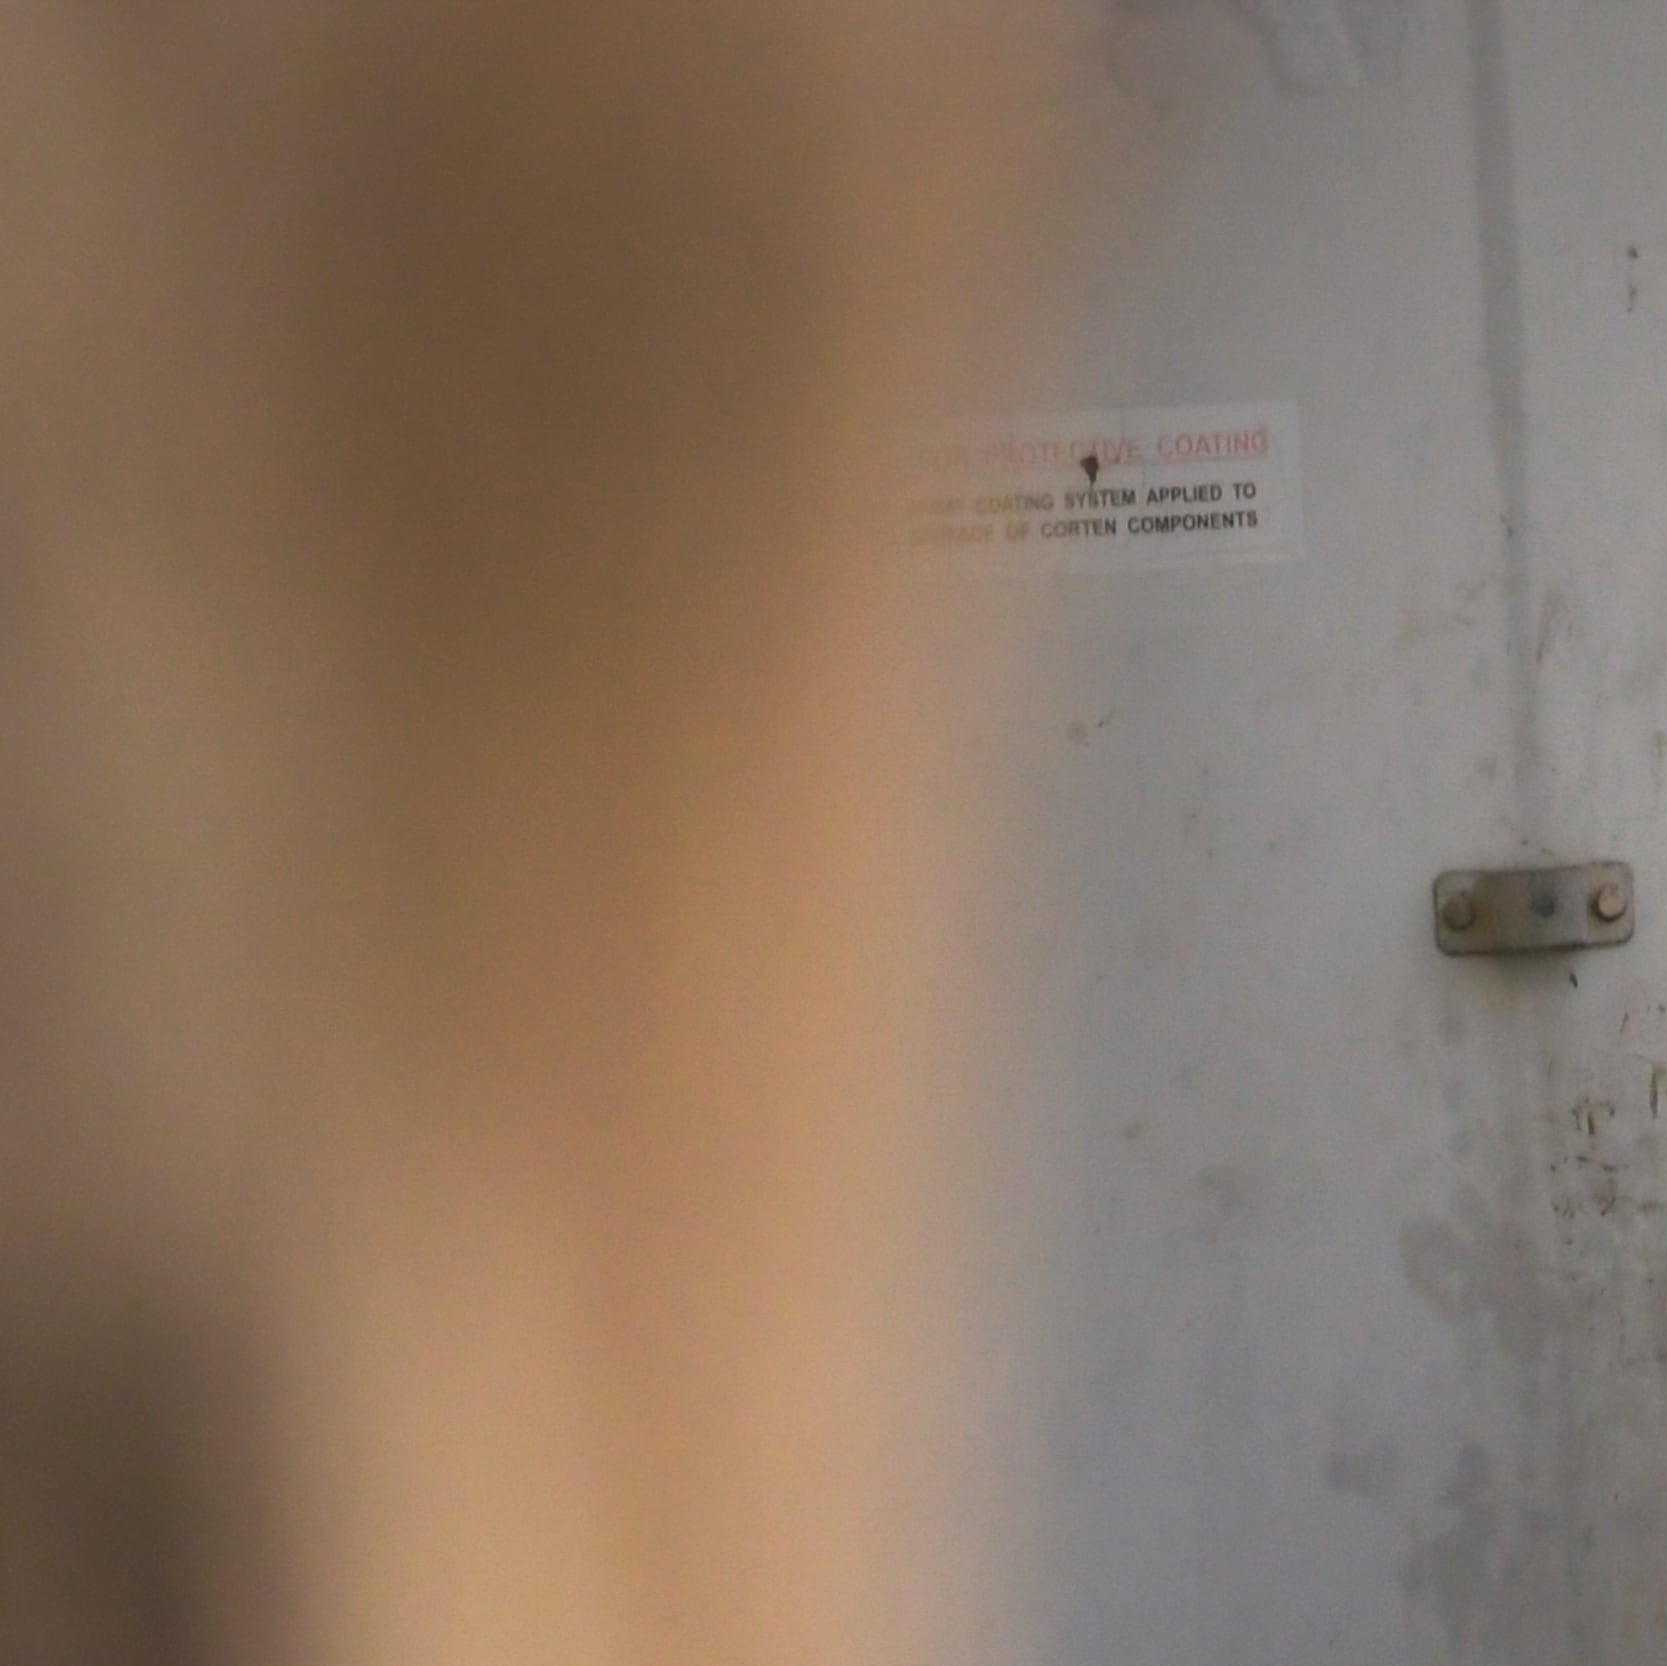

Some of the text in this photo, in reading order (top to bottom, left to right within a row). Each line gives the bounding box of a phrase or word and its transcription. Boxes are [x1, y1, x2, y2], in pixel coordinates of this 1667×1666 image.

[1157, 427, 1268, 460] COATING
[977, 491, 1054, 514] COATING
[1064, 487, 1137, 510] SYSTEM
[1146, 484, 1222, 506] APPLIED
[1233, 481, 1257, 500] TO
[1040, 516, 1117, 539] CORTEN
[1127, 509, 1258, 534] COMPONENTS
